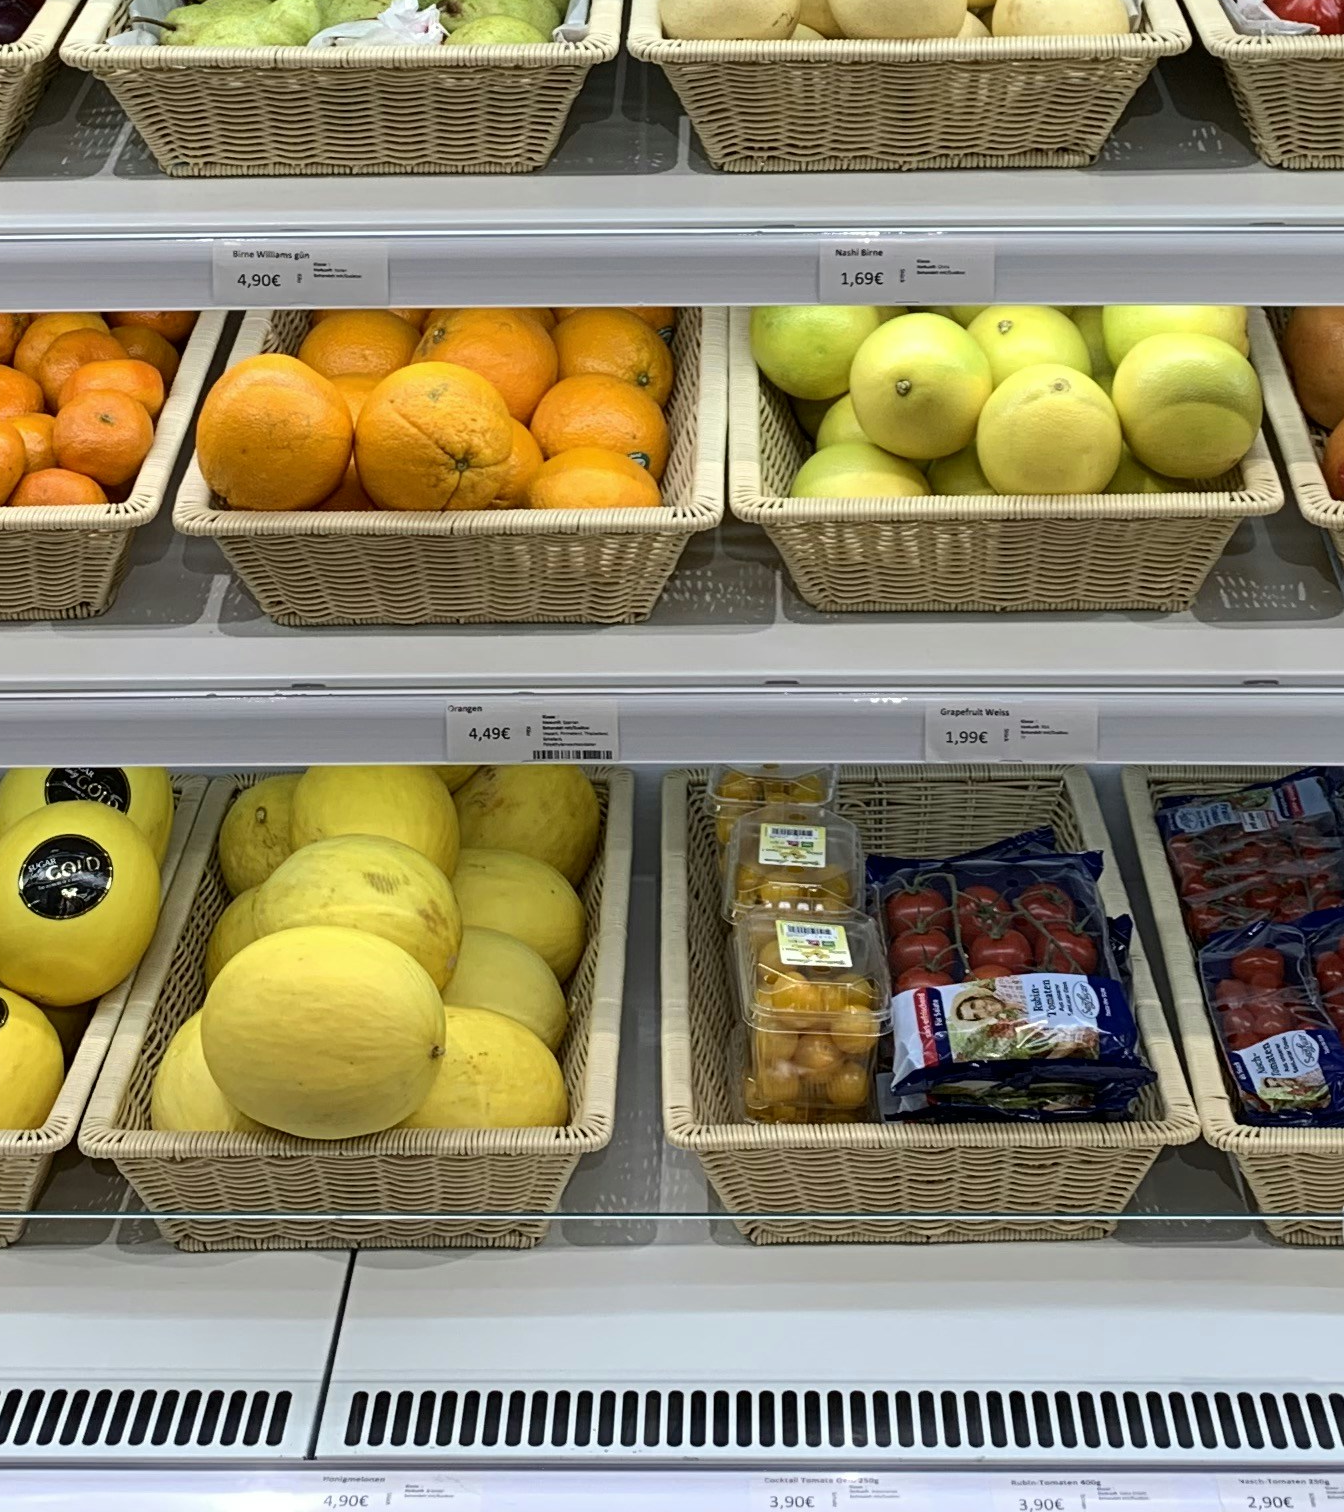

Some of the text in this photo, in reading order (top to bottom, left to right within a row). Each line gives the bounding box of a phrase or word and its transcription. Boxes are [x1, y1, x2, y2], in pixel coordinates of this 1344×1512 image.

[233, 250, 254, 258] Birne
[836, 248, 859, 256] Nashi
[237, 274, 281, 288] 4,90€
[842, 272, 883, 287] 1,69€
[449, 705, 482, 714] Orangen
[941, 708, 983, 717] Grapefruit
[469, 727, 510, 741] 4,49€
[946, 731, 988, 745] 1,99€
[45, 856, 101, 881] GOLD
[1033, 983, 1045, 1012] Rubin-
[1046, 978, 1057, 1018] Tomaten
[324, 1495, 368, 1508] 4,90€
[770, 1496, 814, 1509] 3,90€
[1019, 1499, 1064, 1512] 3,90€
[1248, 1497, 1294, 1510] 2,90€
